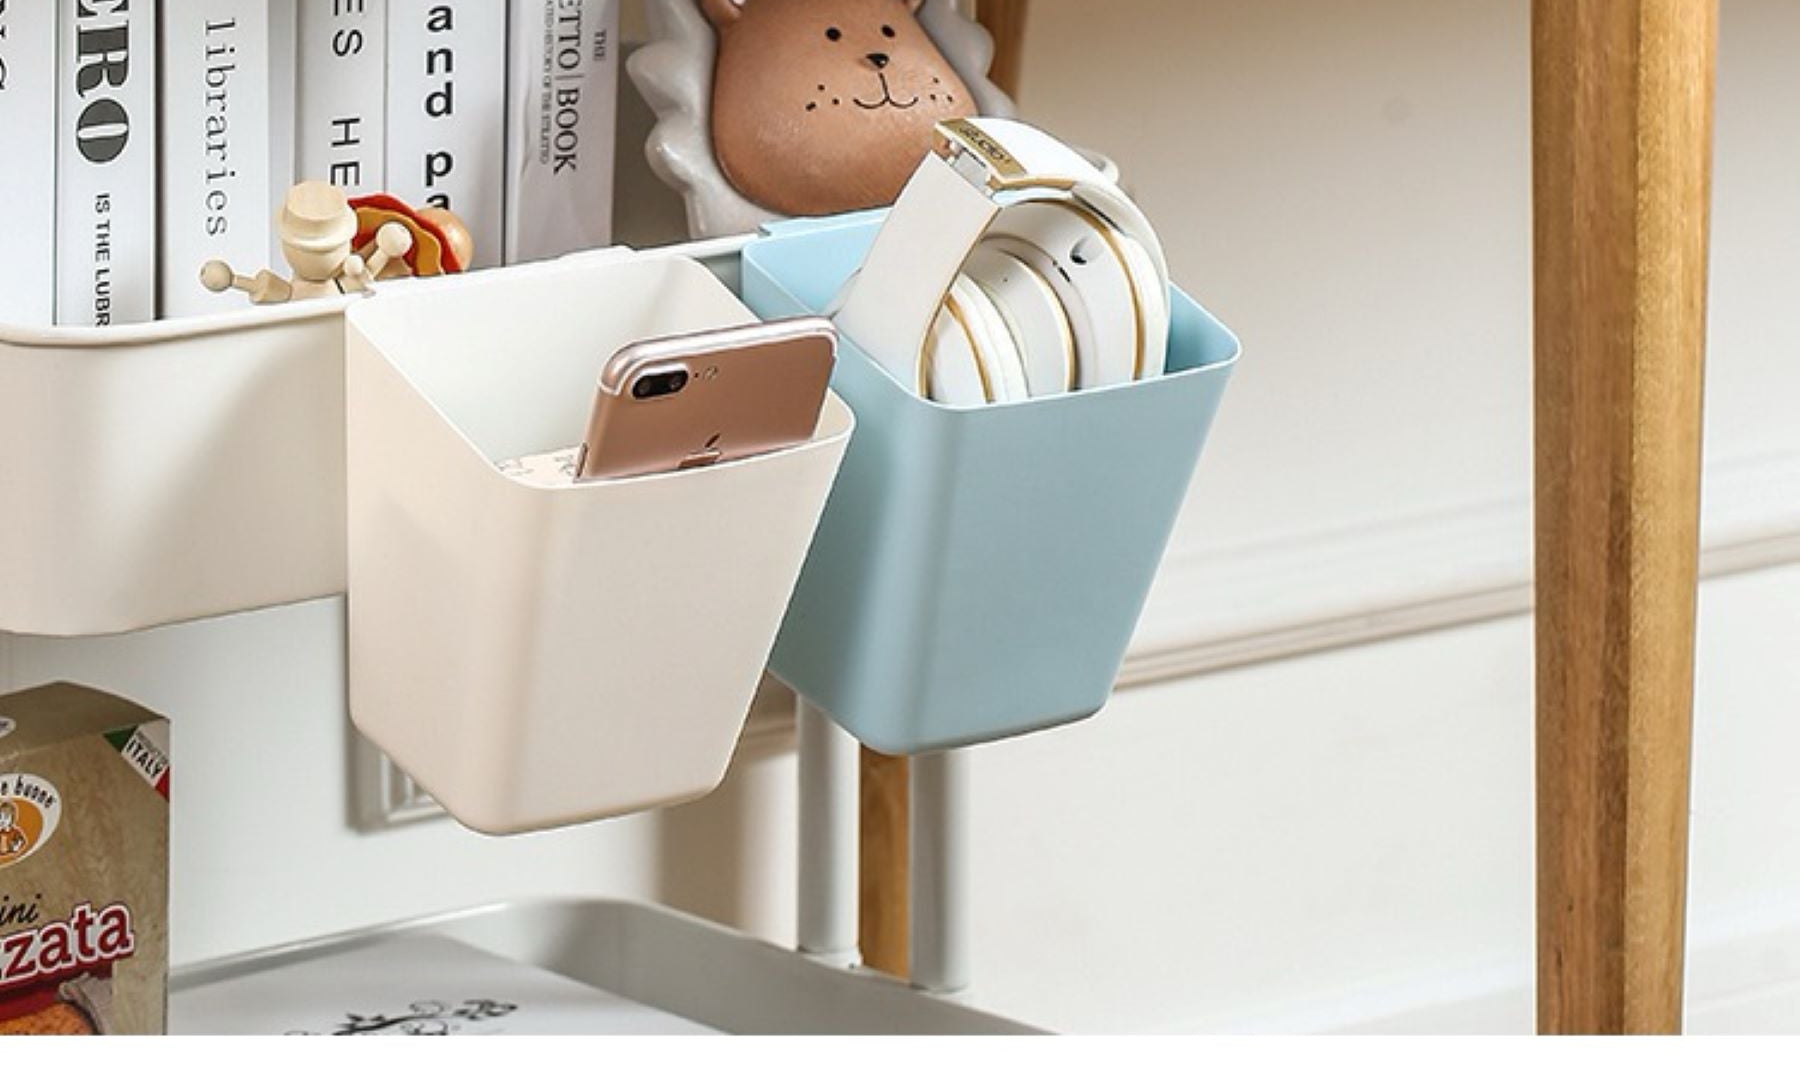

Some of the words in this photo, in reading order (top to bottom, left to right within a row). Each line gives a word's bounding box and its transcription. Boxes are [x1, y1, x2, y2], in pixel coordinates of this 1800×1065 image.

[424, 5, 454, 119] and
[593, 30, 606, 60] THE
[204, 16, 237, 237] libraries
[553, 87, 580, 176] BOOK
[95, 192, 111, 214] IS
[95, 218, 111, 263] THE
[95, 268, 111, 327] LUBR
[126, 739, 163, 778] ITALY
[0, 904, 131, 980] zata
